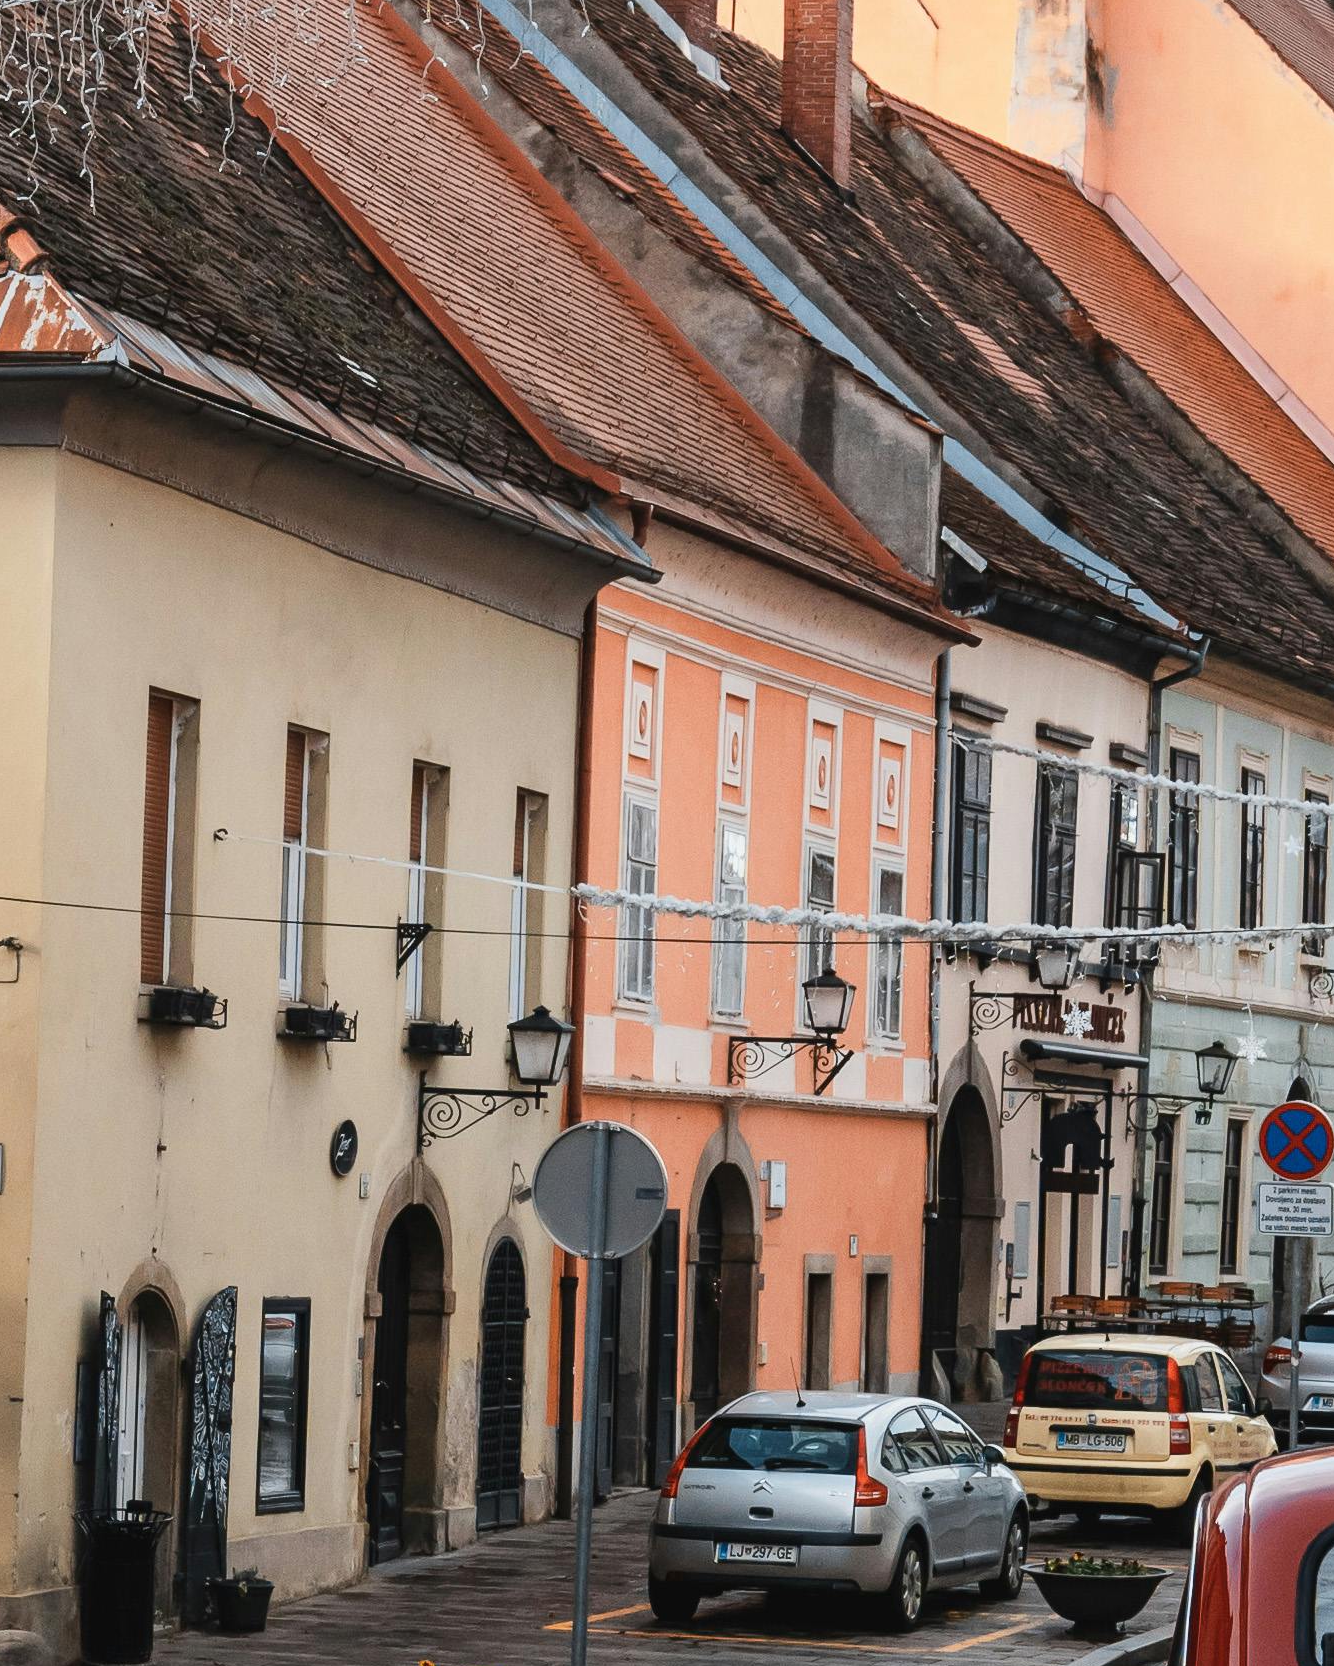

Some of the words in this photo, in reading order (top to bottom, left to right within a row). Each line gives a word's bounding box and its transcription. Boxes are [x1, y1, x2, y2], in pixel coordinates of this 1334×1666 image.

[1066, 1434, 1080, 1445] MB
[1087, 1435, 1123, 1447] LG-506
[729, 1544, 744, 1558] LJ
[752, 1545, 794, 1560] 297-GE
